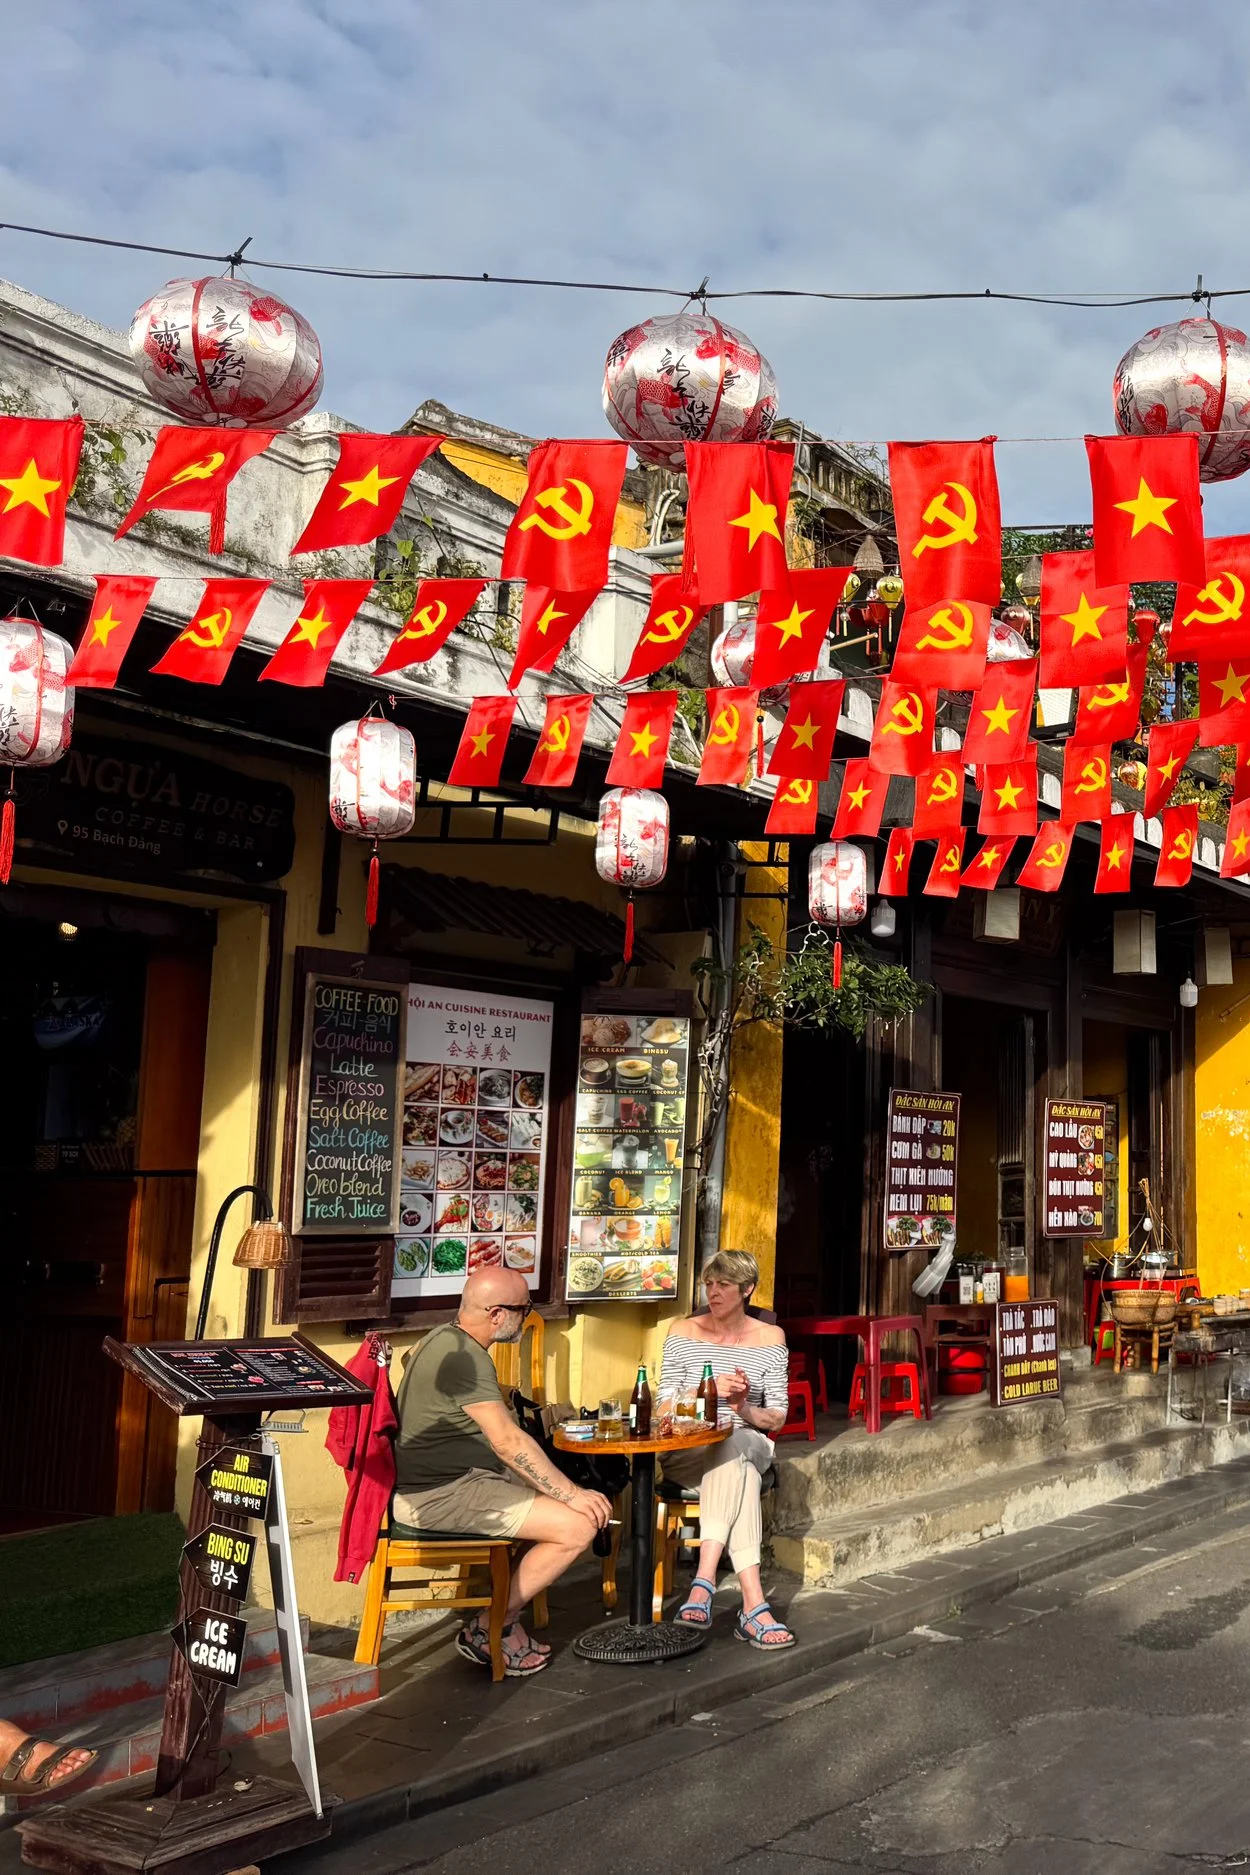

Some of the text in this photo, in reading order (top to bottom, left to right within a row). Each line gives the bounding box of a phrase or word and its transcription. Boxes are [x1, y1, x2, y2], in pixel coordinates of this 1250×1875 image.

[189, 790, 284, 828] HORSE
[72, 825, 89, 840] 95
[92, 829, 125, 848] Bạch
[95, 807, 256, 852] COFFEE & BAR
[427, 1000, 442, 1010] AN
[445, 1002, 487, 1016] CUISINE
[489, 1008, 552, 1023] RESTAURANT
[445, 1020, 516, 1042] 호이안 요리
[447, 1040, 511, 1061] 会安美食
[330, 1053, 379, 1077] Latte
[315, 1075, 384, 1105] Espresso
[310, 1099, 388, 1128] Egg Coffee
[309, 1126, 389, 1155] Salt Coffee
[1050, 1122, 1063, 1137] CAO
[307, 1149, 391, 1178] Coconut Coffee
[306, 1172, 385, 1196] Oreo blend
[306, 1196, 386, 1218] Fresh Juice
[1004, 1384, 1021, 1399] COLD
[1042, 1378, 1058, 1392] BEER
[233, 1454, 250, 1473] AIR
[211, 1469, 268, 1497] CONDITIONER
[207, 1533, 250, 1566] BING SU
[210, 1559, 239, 1590] 빙수
[204, 1618, 229, 1645] ICE
[190, 1641, 237, 1675] CREAM
